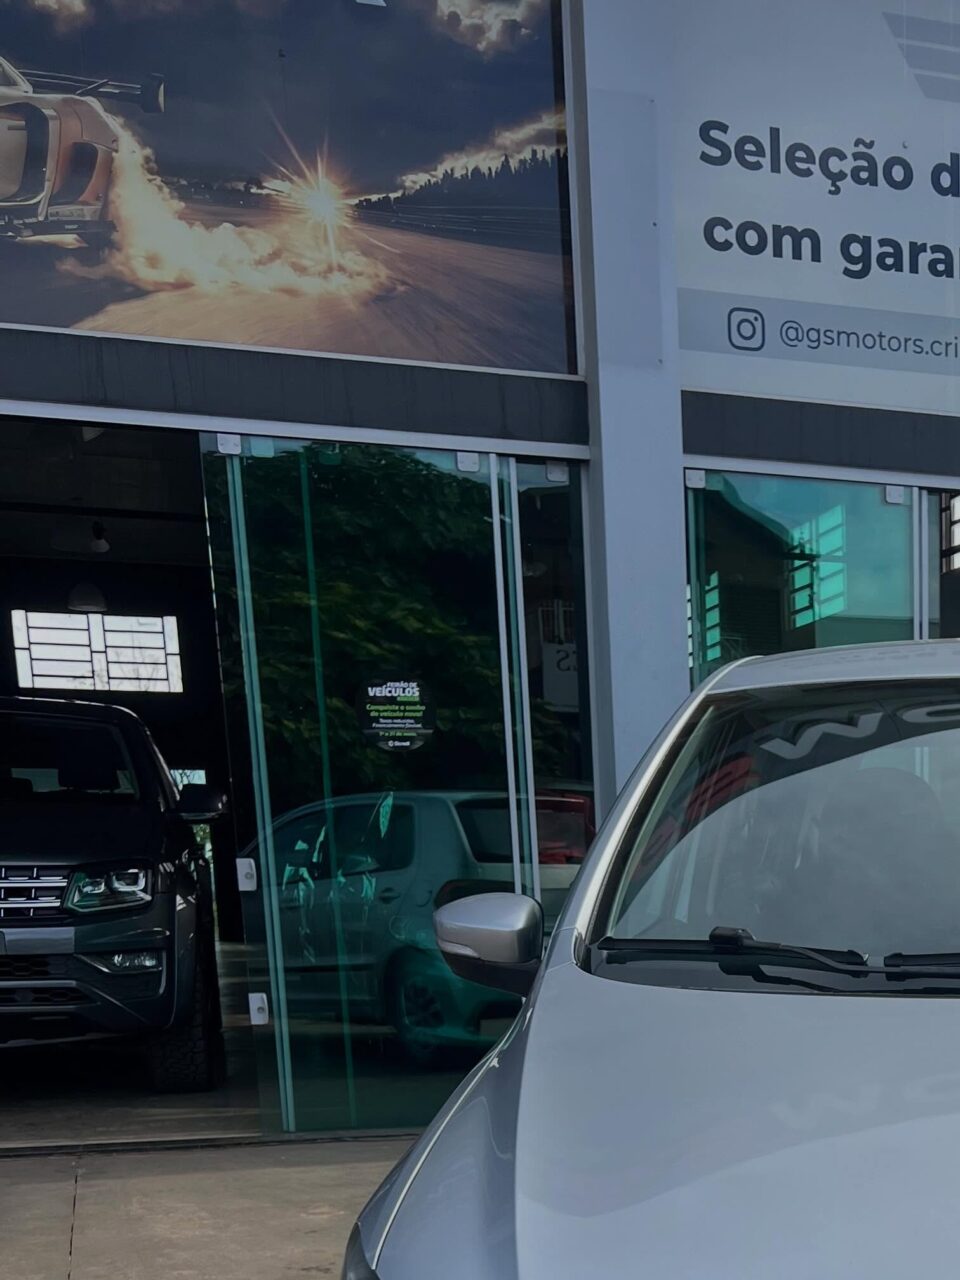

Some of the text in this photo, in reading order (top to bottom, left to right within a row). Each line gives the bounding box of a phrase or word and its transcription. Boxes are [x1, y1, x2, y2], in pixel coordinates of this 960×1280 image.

[699, 120, 914, 197] Seleção
[703, 217, 822, 264] com
[368, 685, 420, 696] VEÍCULOS
